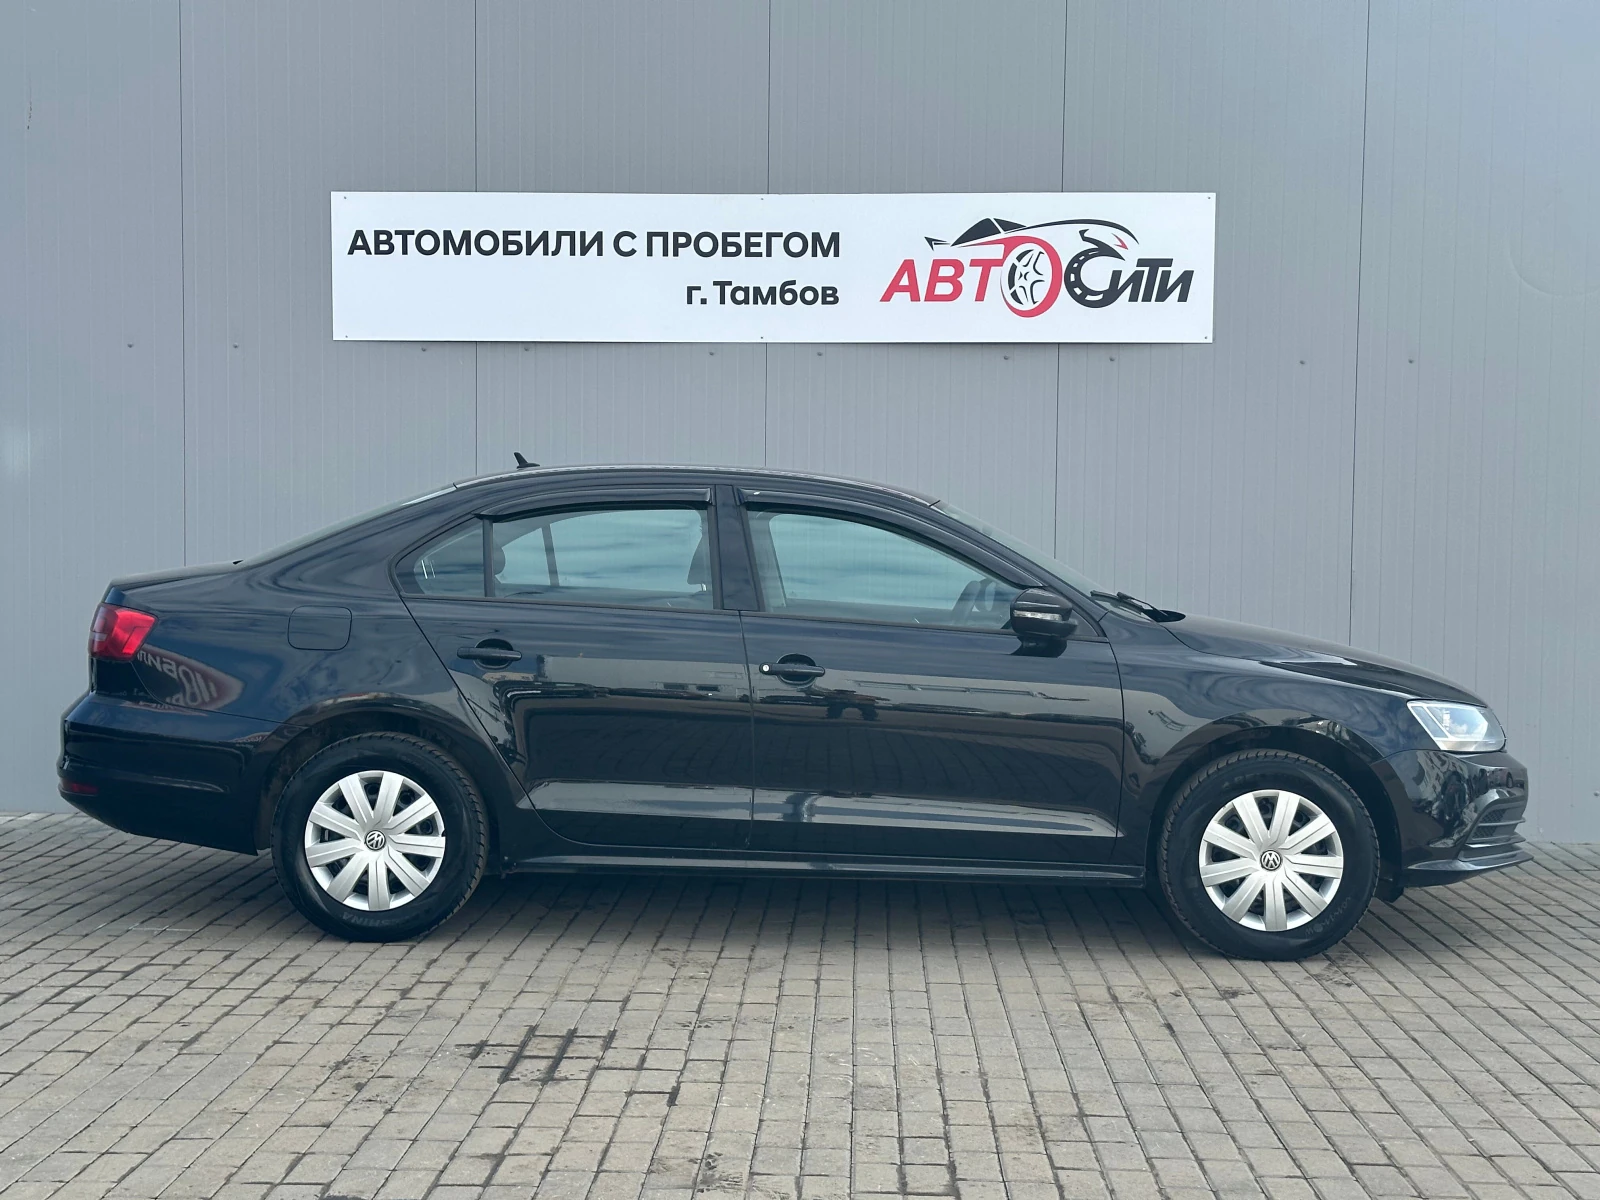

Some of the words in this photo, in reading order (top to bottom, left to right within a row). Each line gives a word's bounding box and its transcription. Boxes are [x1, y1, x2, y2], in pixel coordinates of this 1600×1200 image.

[347, 229, 604, 257] АВТОМОБИЛИ
[612, 230, 637, 258] С
[646, 231, 840, 259] ПРОБЕГОМ
[686, 285, 708, 305] г.
[712, 279, 840, 306] Тамбов
